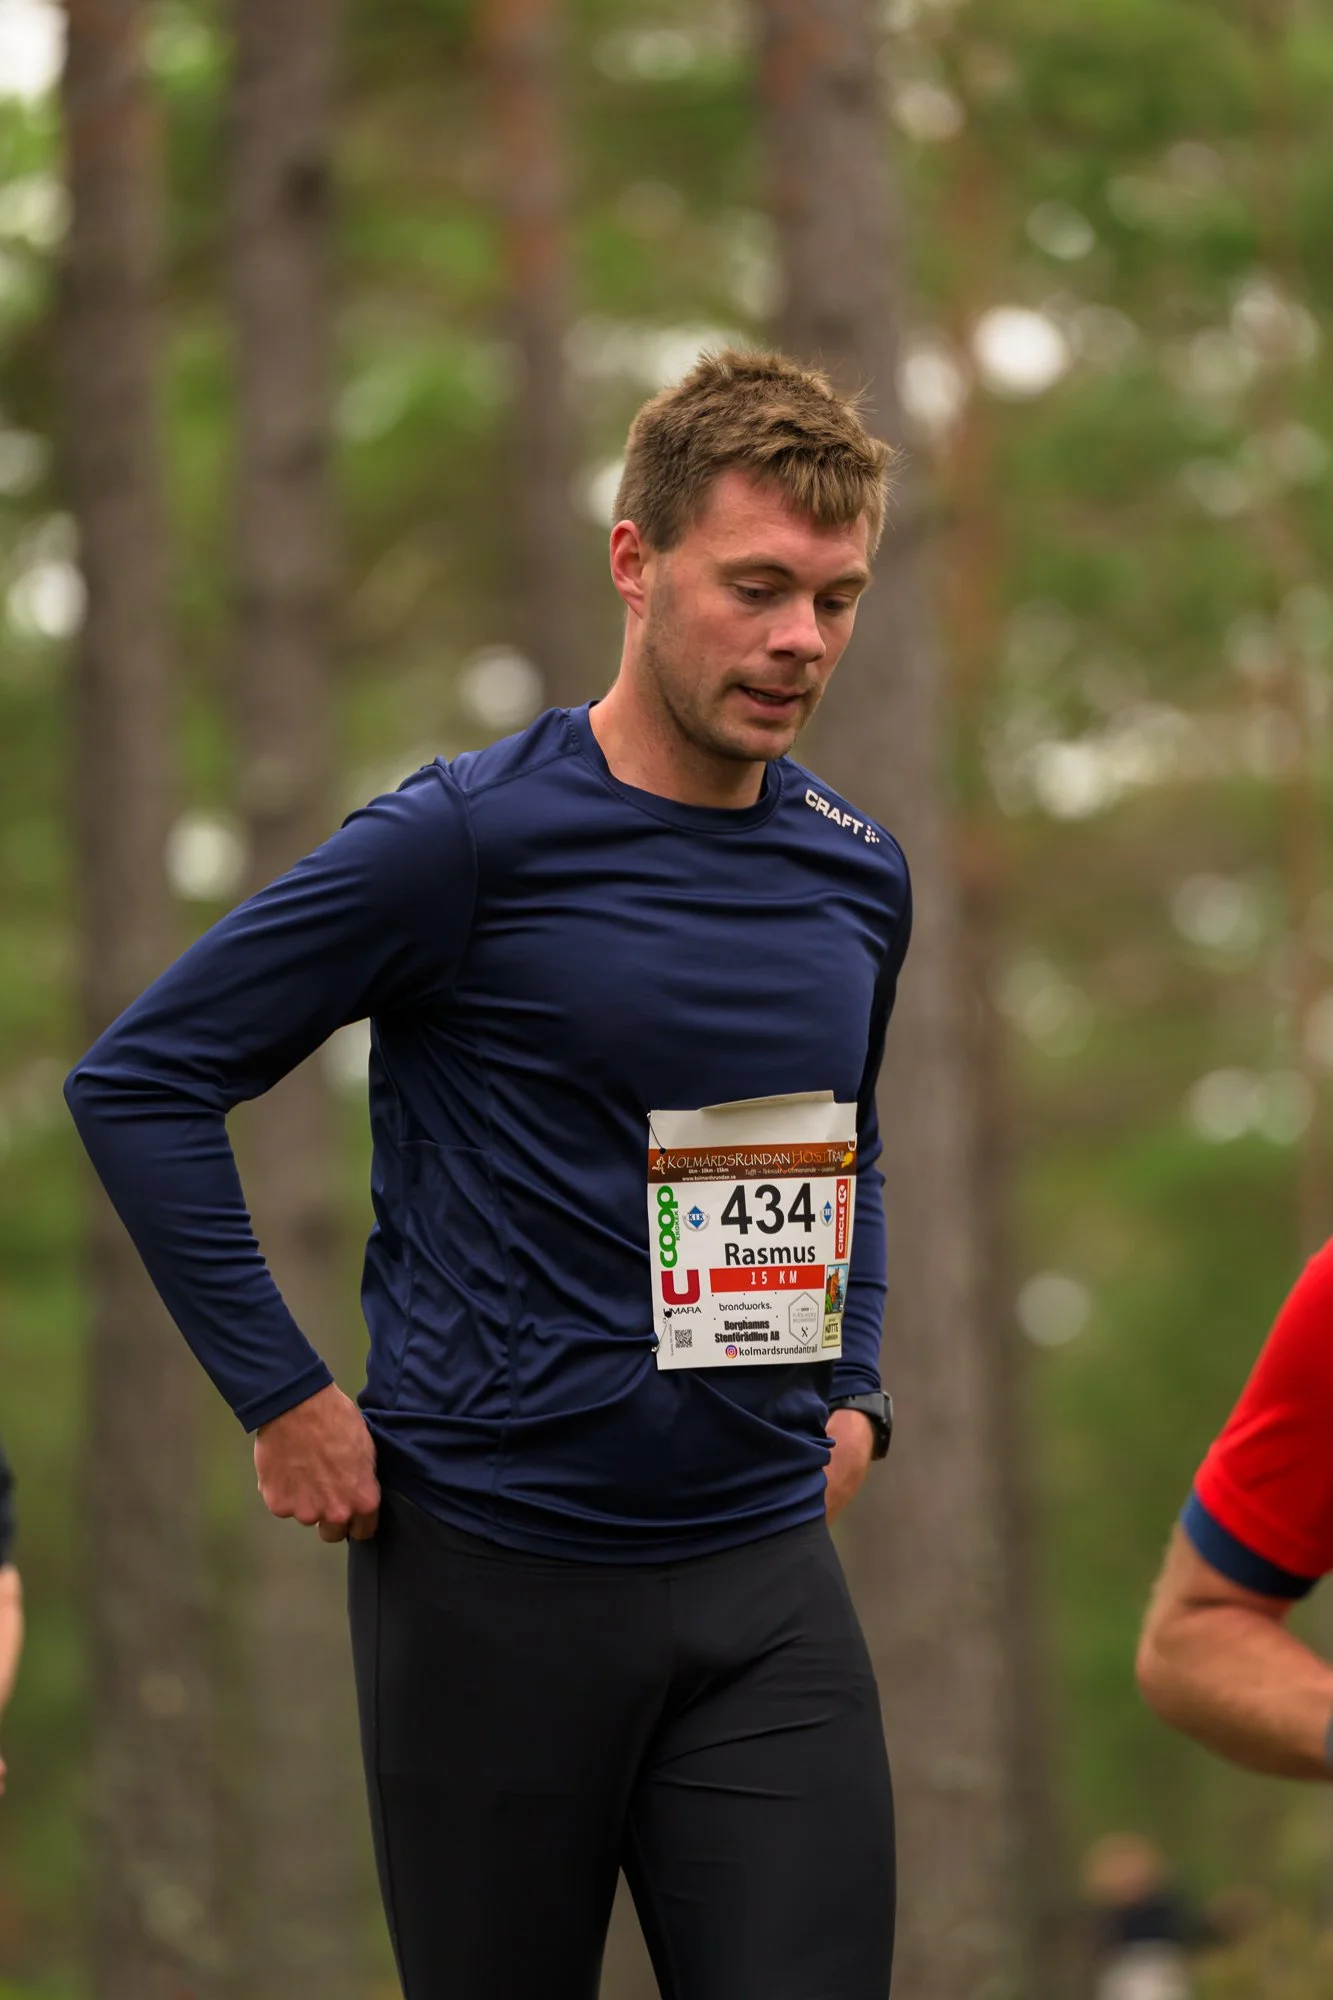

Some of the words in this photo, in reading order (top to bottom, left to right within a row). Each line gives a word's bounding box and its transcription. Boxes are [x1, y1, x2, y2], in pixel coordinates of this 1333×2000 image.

[805, 789, 864, 835] CRAFT
[721, 1183, 815, 1234] 434
[657, 1185, 679, 1268] coop
[725, 1243, 816, 1266] Rasmus
[751, 1271, 767, 1285] 15
[779, 1270, 797, 1284] KM
[724, 1320, 770, 1331] Borghamns
[715, 1332, 768, 1344] Stenförädling
[770, 1331, 780, 1341] AB
